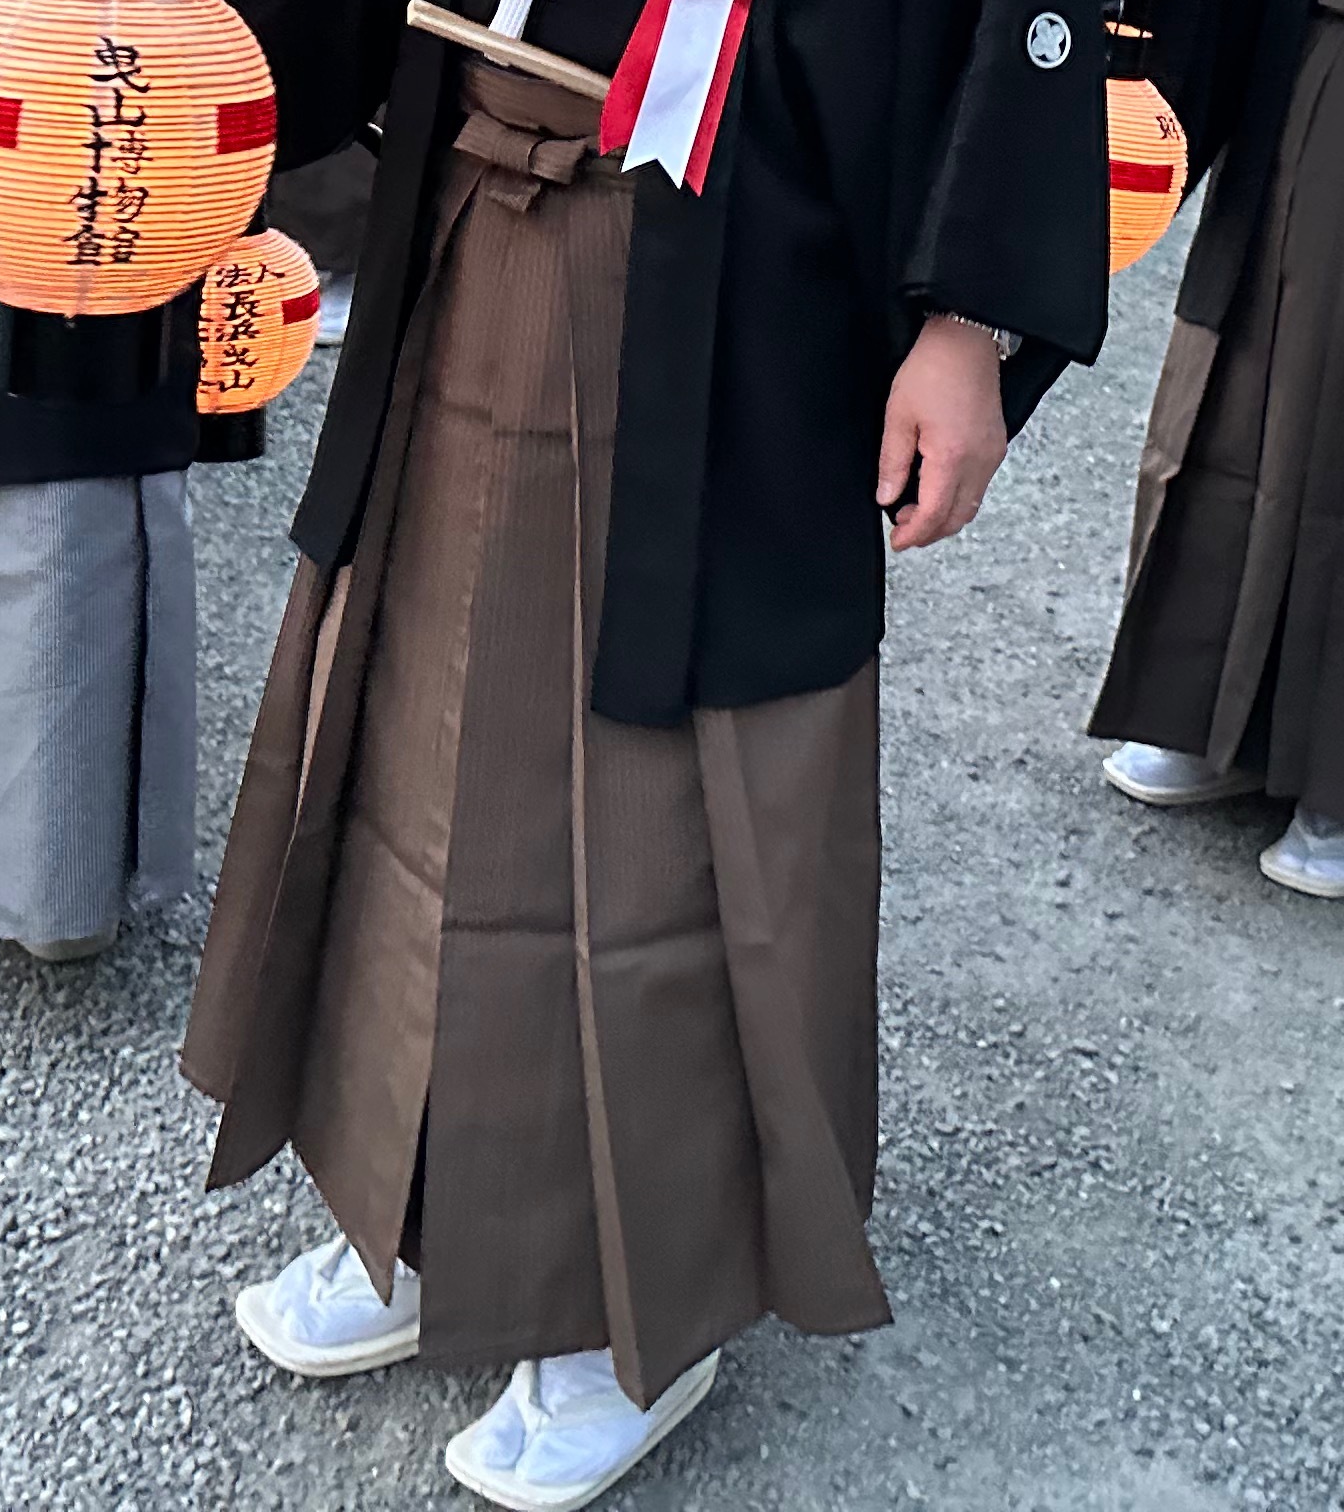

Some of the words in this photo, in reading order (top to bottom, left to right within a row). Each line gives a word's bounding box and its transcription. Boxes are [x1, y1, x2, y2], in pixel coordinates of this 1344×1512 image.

[62, 36, 154, 267] 曳山博物館
